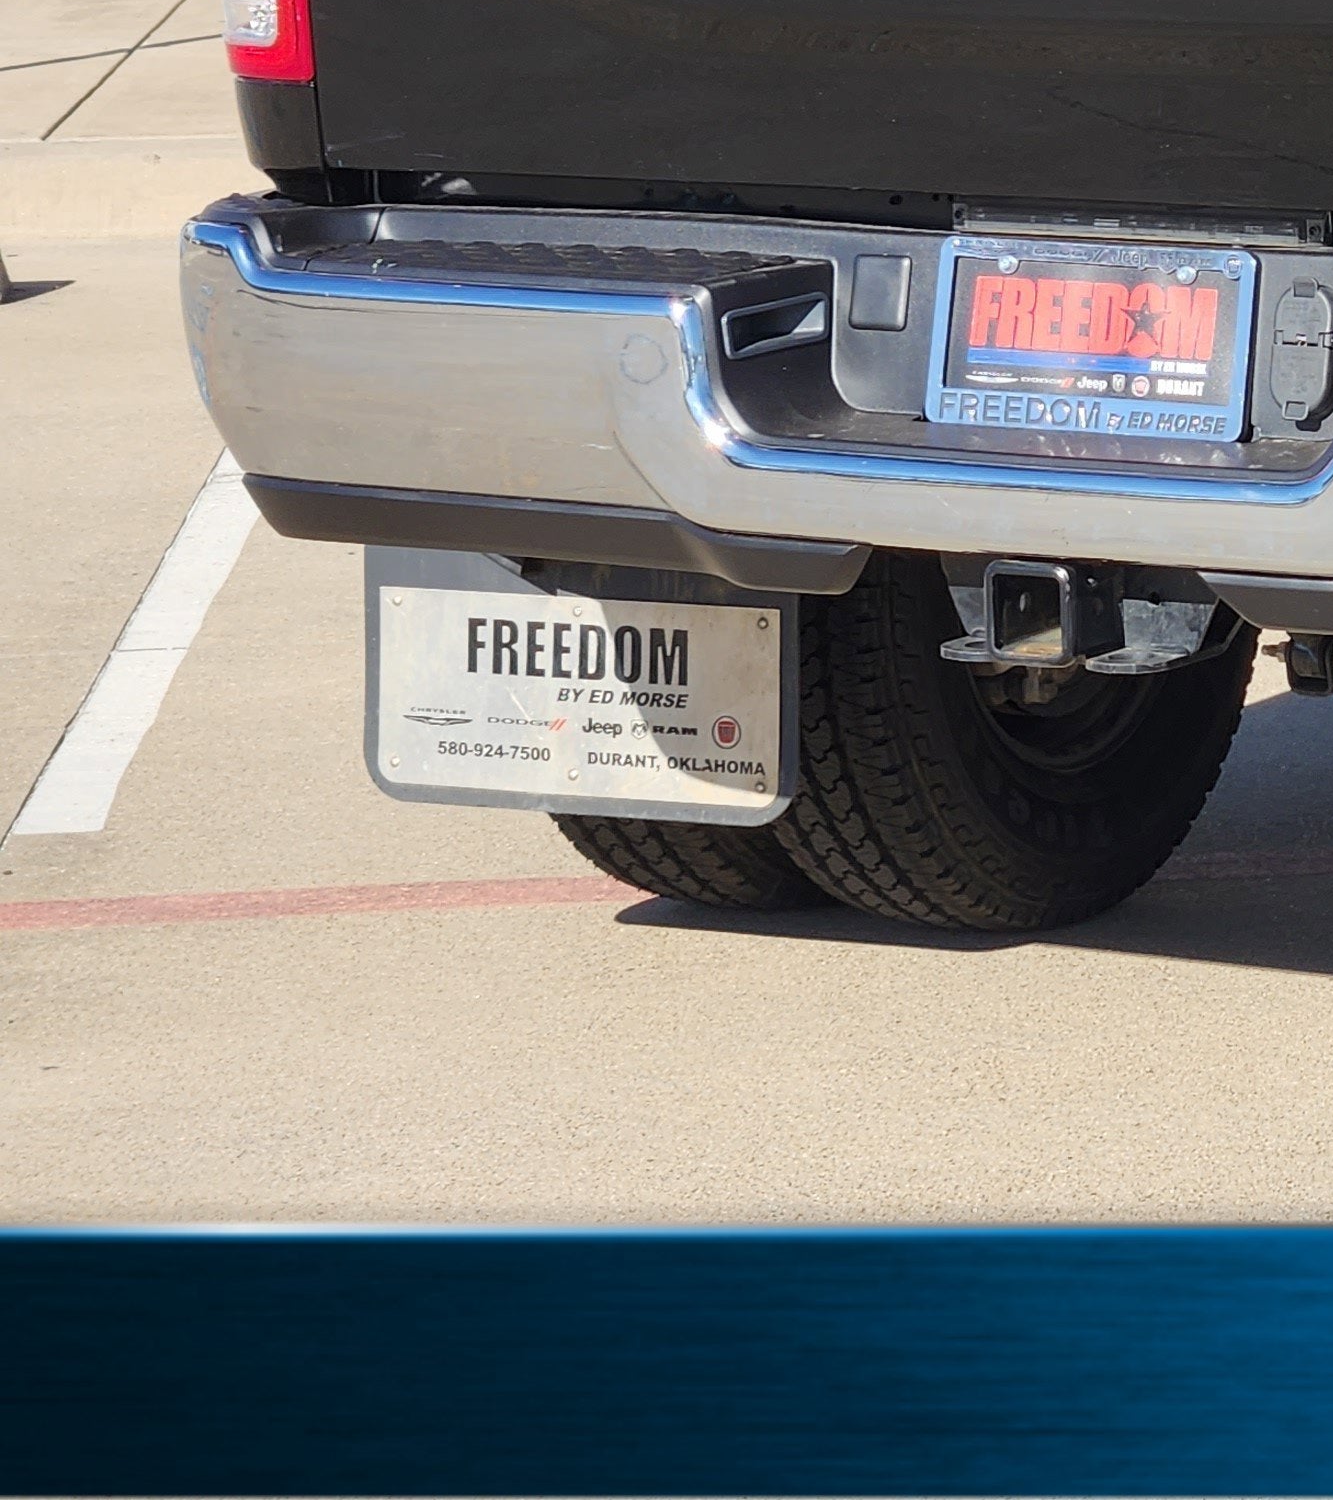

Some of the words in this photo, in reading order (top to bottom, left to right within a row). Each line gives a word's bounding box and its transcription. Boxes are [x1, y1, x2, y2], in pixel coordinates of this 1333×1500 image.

[968, 275, 1219, 360] FREEDOM
[1076, 376, 1108, 392] Jeep
[939, 392, 1100, 430] FREEDOM
[1127, 411, 1153, 430] ED
[1156, 412, 1227, 436] MORSE
[467, 617, 689, 687] FREEDOM
[558, 688, 584, 703] BY
[588, 690, 614, 704] ED
[619, 691, 690, 709] MORSE
[410, 706, 467, 716] CHRYSLER
[582, 717, 623, 739] Jeep
[652, 725, 698, 736] RAM
[437, 740, 551, 762] 580-924-7500
[587, 751, 661, 772] DURANT,
[667, 756, 766, 776] OKLAHOMA
